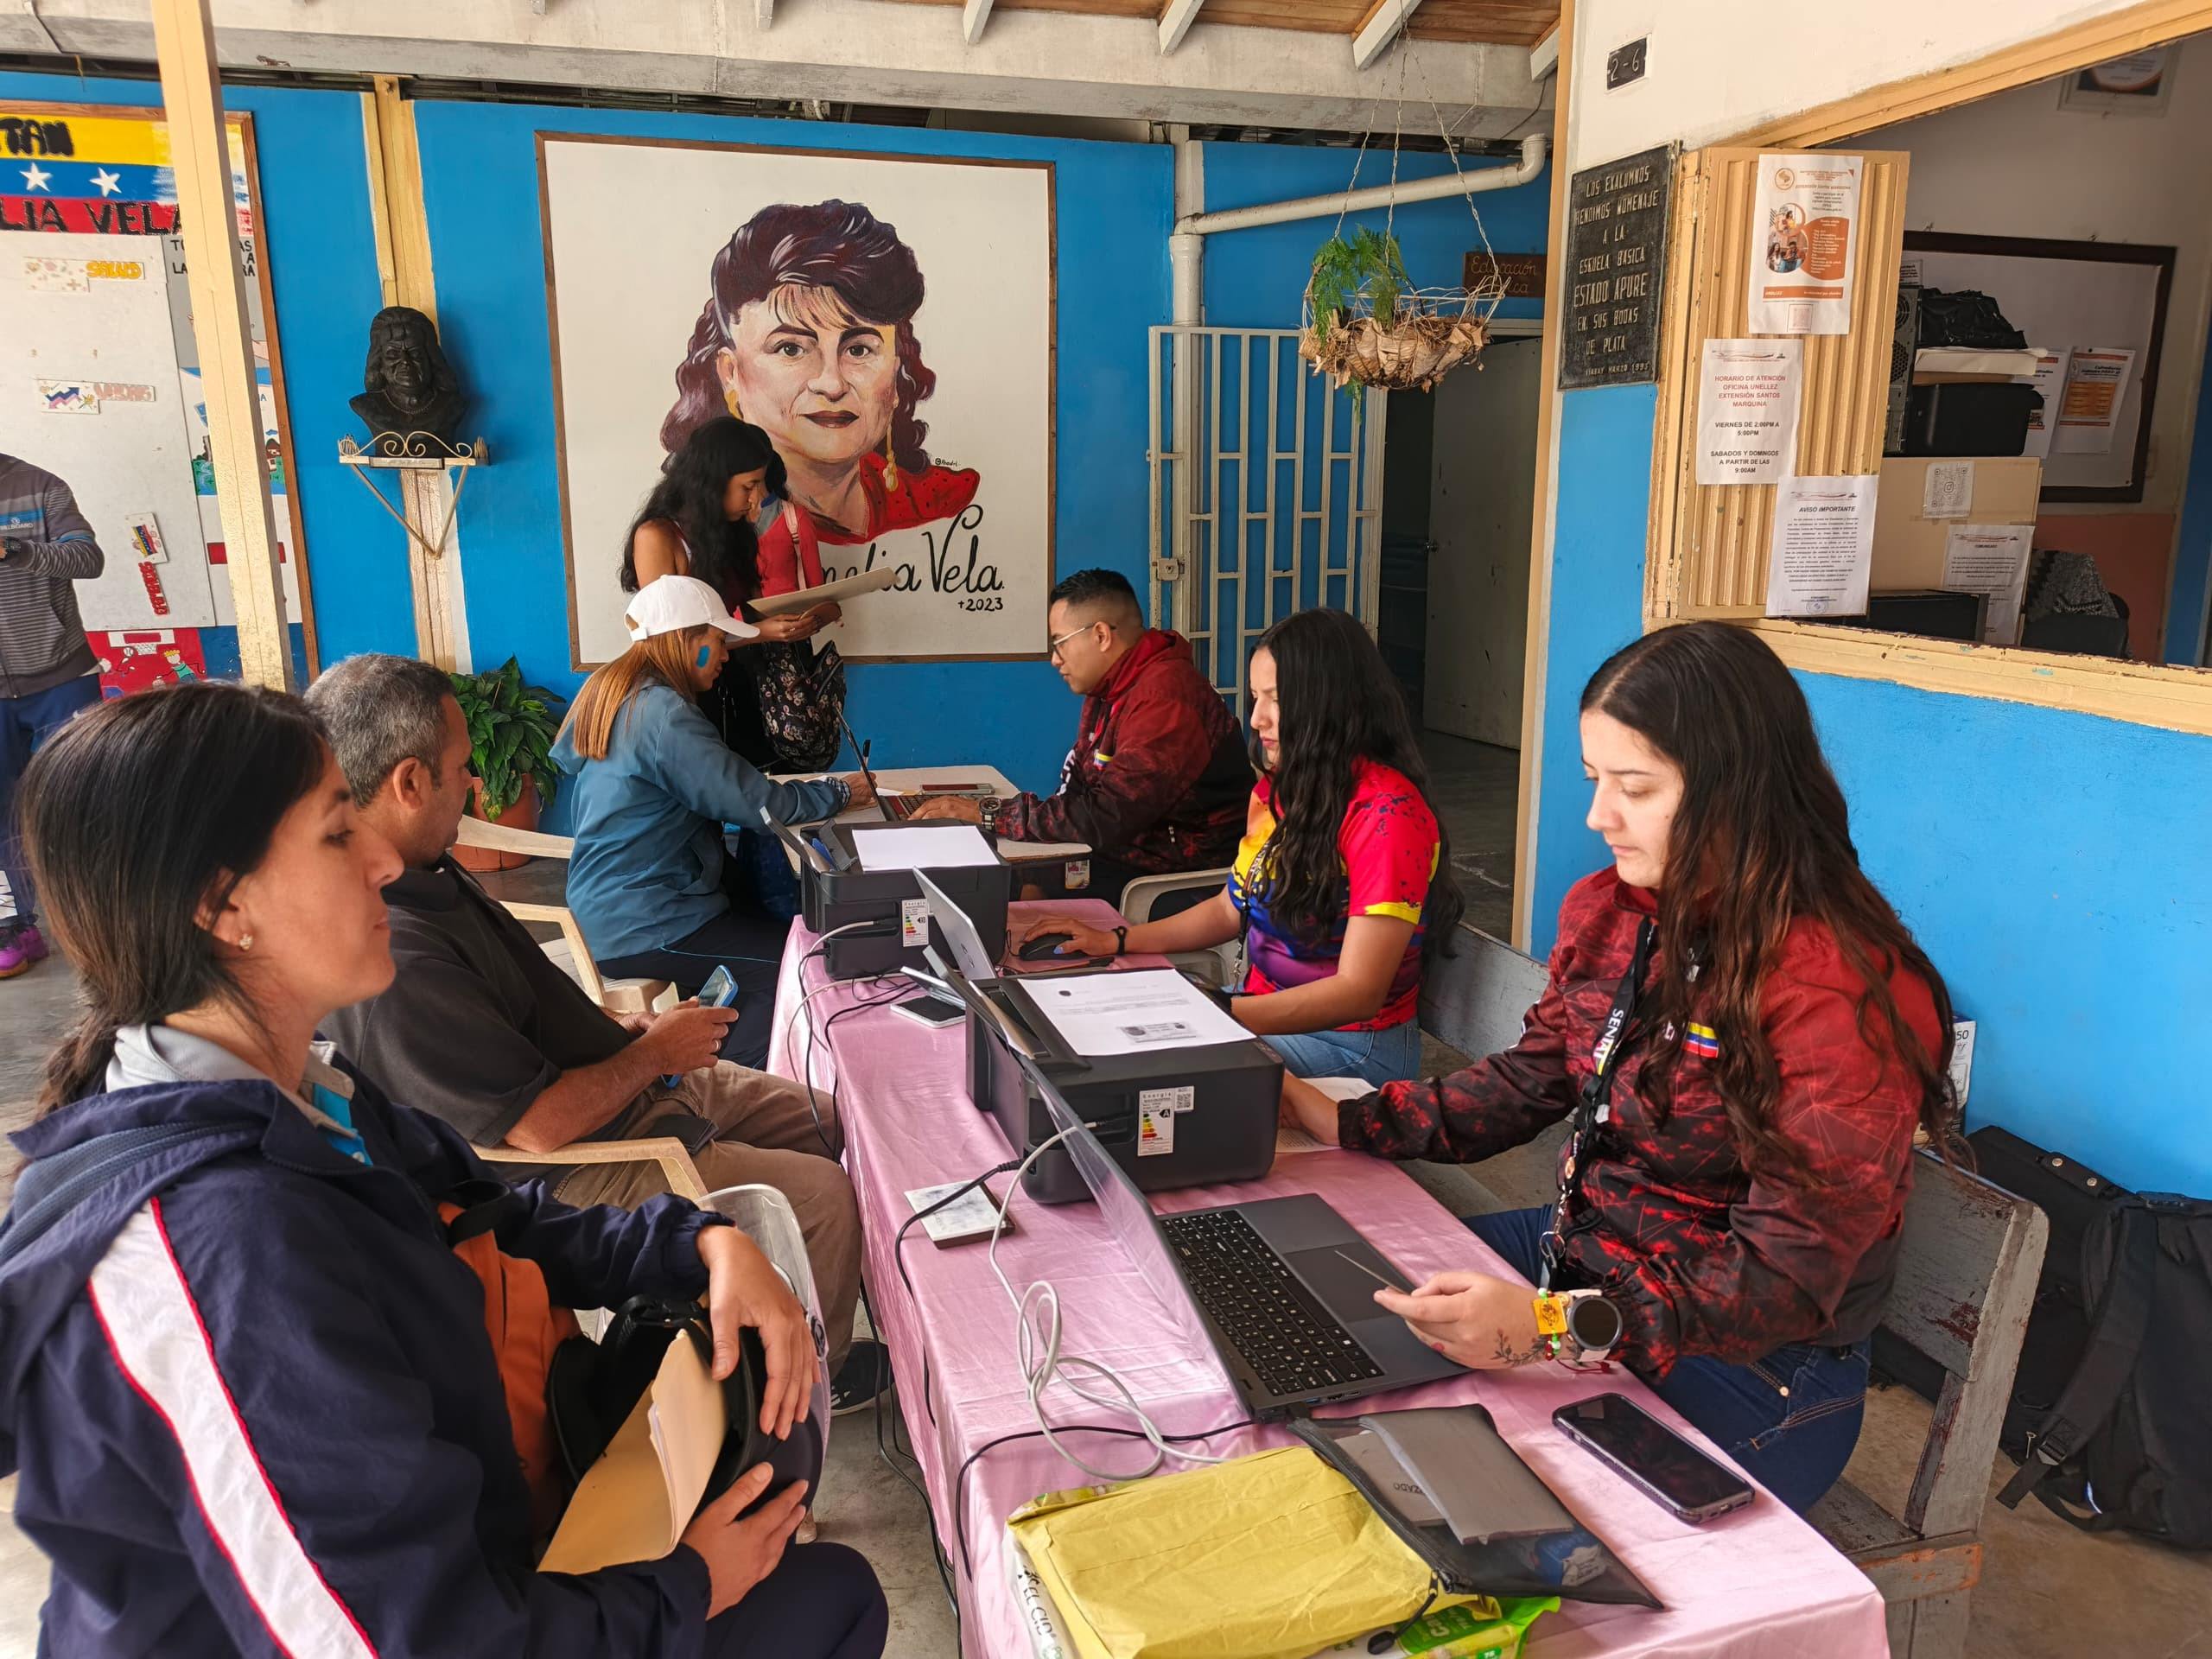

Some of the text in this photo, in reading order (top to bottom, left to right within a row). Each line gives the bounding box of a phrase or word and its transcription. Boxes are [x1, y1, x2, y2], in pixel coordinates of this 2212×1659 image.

[1586, 165, 1650, 198] LOS EXALUMNOS
[1574, 189, 1660, 226] RENDIMOS HOMENAJE
[1573, 271, 1649, 308] ESTADO APURE
[1592, 311, 1608, 330] SUS
[1613, 306, 1639, 327] BODAS
[1586, 334, 1626, 356] DE PLATA
[1608, 363, 1628, 375] MARZO
[1592, 1007, 1625, 1066] SENIAT
